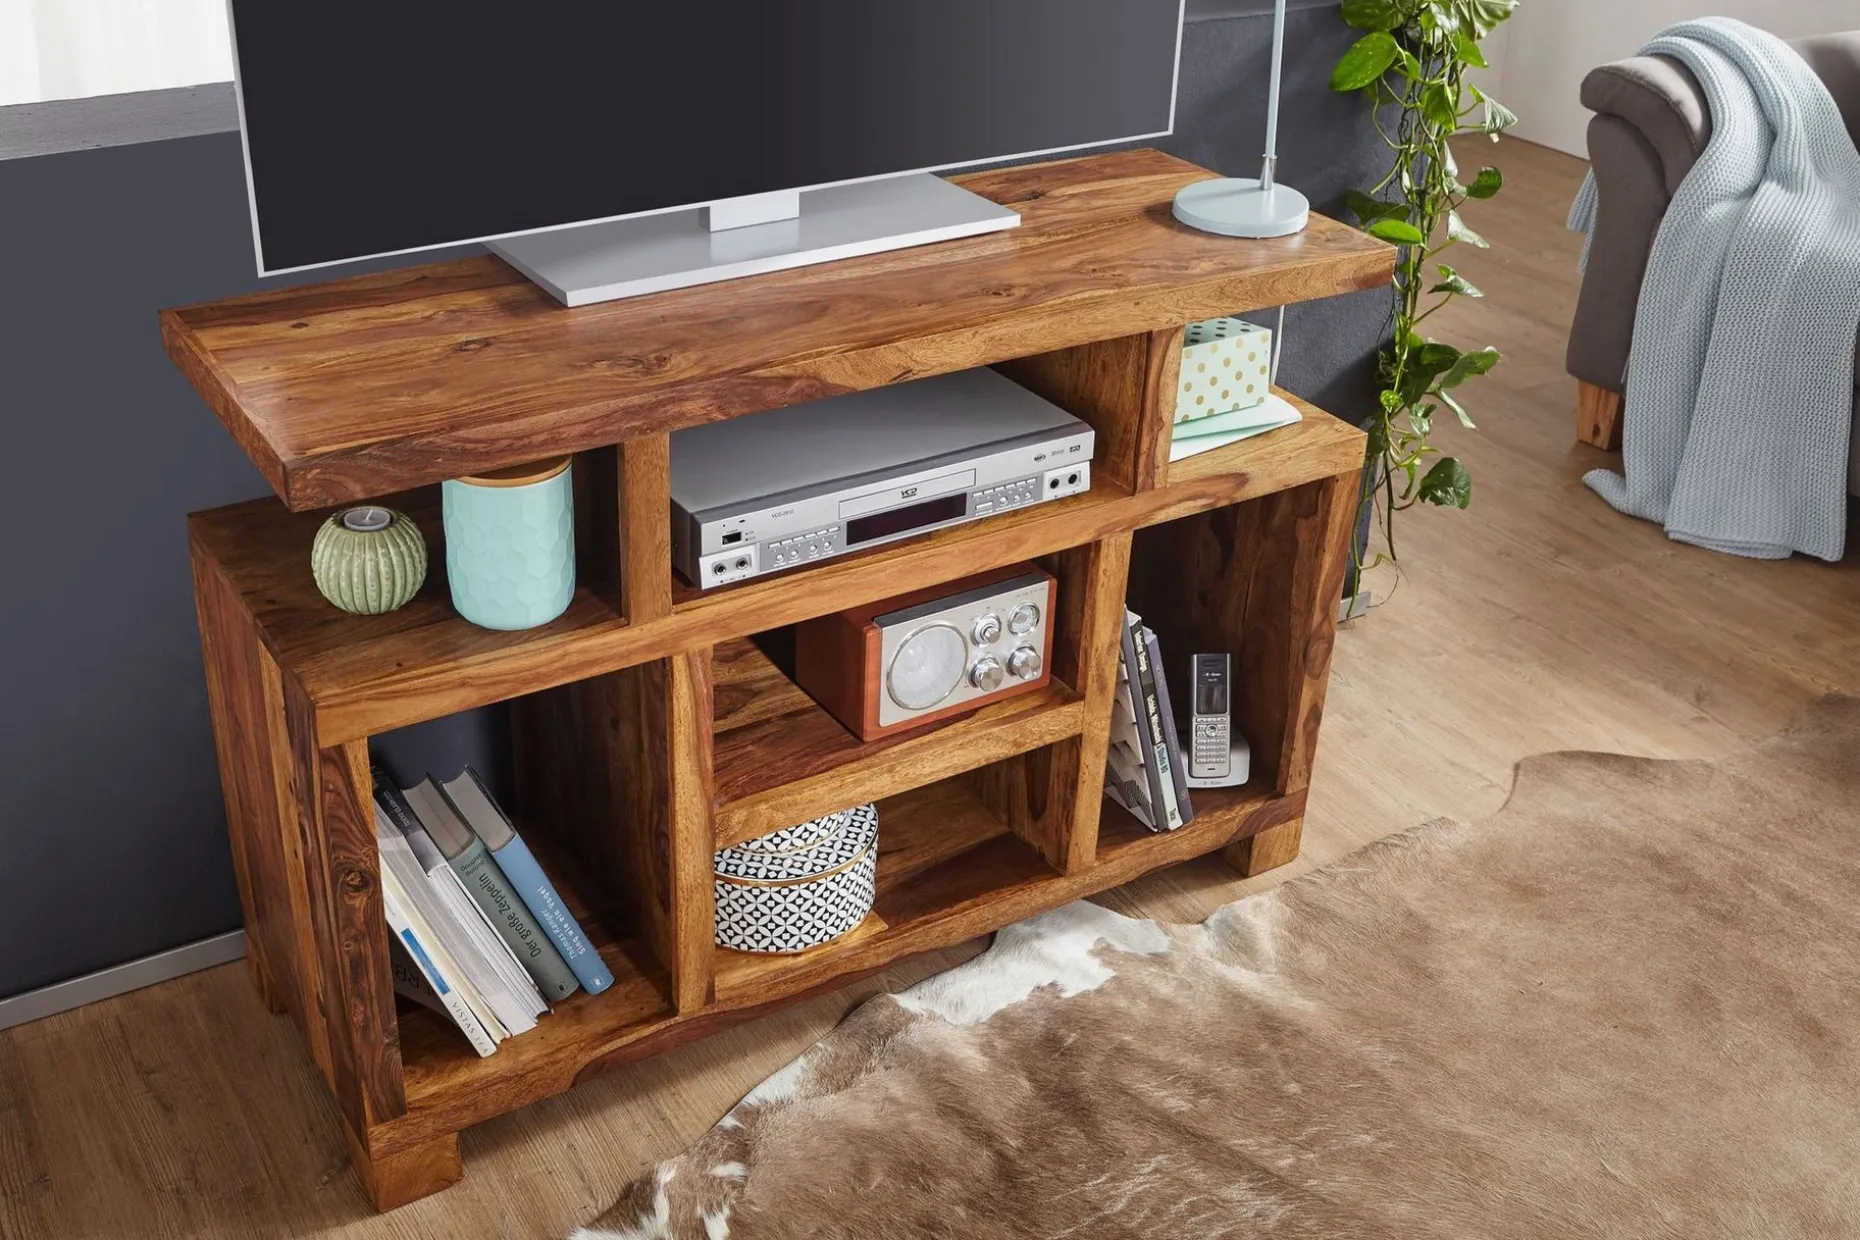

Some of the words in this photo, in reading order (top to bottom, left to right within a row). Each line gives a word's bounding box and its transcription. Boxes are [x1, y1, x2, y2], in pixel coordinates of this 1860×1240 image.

[478, 873, 511, 916] Zeppelin
[536, 885, 555, 910] Vogel
[507, 912, 532, 940] große
[541, 909, 561, 934] Kanger
[553, 908, 565, 922] ein
[563, 923, 575, 937] wie
[525, 938, 542, 958] Der
[557, 933, 578, 960] Thomas
[572, 936, 587, 955] Sing
